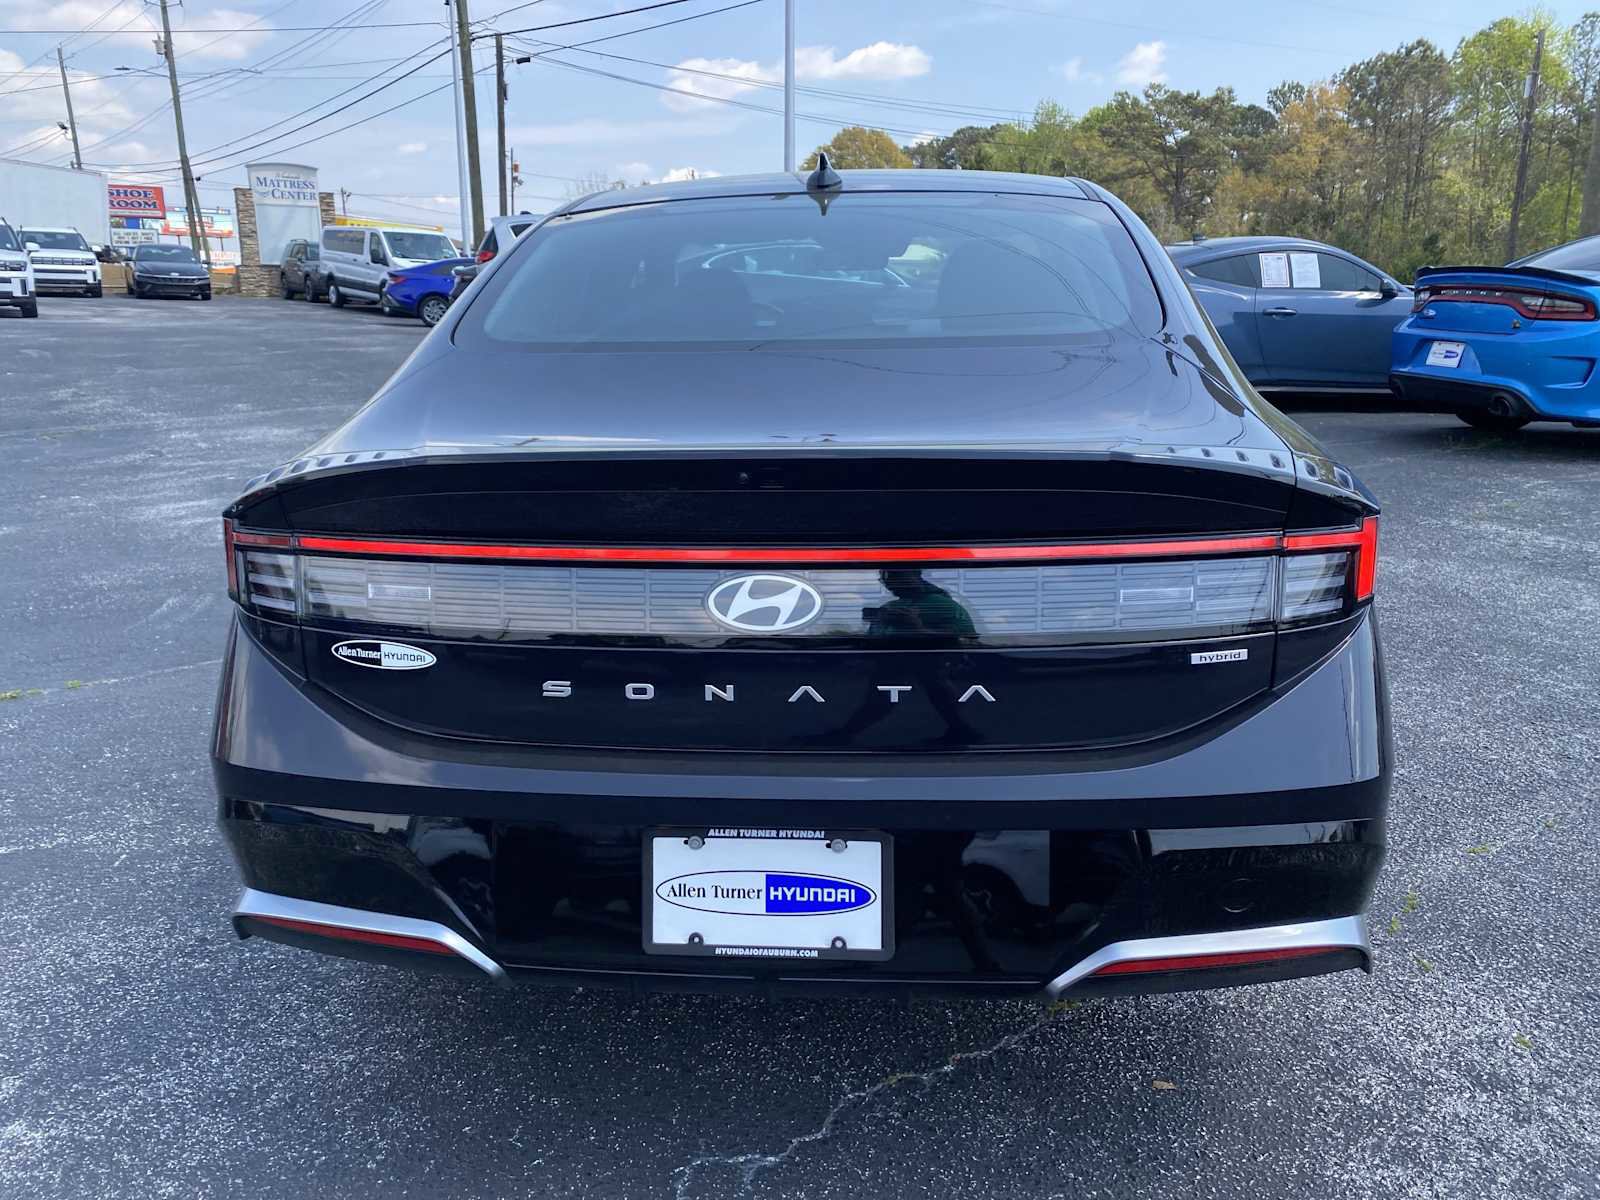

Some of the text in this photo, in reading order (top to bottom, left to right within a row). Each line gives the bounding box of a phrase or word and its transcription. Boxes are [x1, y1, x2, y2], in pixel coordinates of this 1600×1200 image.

[256, 176, 316, 190] MATTRESS
[271, 188, 317, 201] CENTER
[338, 646, 426, 663] Allen Turner HYUNDAI
[1200, 651, 1241, 663] hybrid
[542, 680, 997, 703] SONATA
[708, 828, 825, 839] ALLEN TURNER HYUNDAI
[666, 883, 856, 904] Allen Turner HYUNDAI
[715, 947, 819, 958] HYUNDAIOFAUBURN.COM
